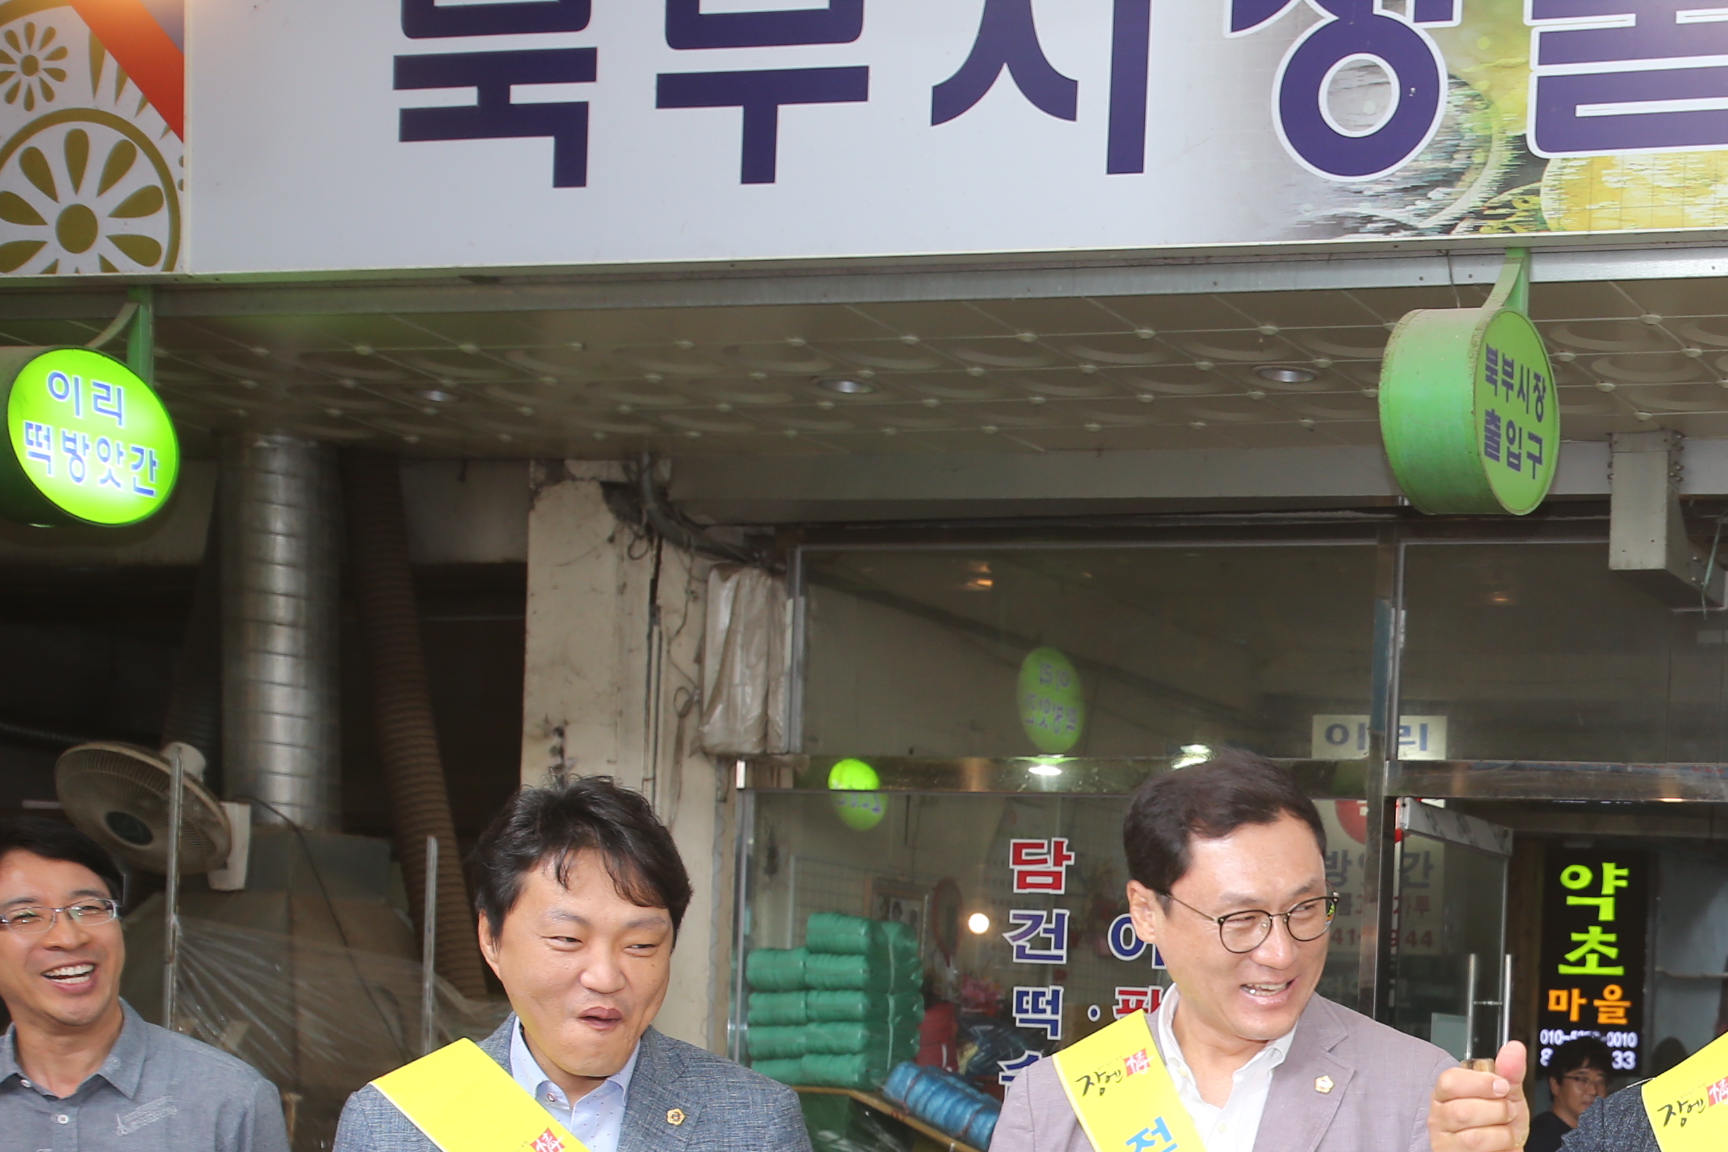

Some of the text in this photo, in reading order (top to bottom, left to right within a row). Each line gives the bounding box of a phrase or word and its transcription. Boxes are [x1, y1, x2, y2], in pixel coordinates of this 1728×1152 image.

[47, 370, 126, 430] 이리
[1485, 343, 1546, 423] 북부시장
[23, 420, 159, 497] 떡방앗간
[1484, 408, 1543, 480] 출입구
[1009, 837, 1075, 894] 담
[1559, 862, 1629, 976] 약초
[1548, 983, 1632, 1025] 마을
